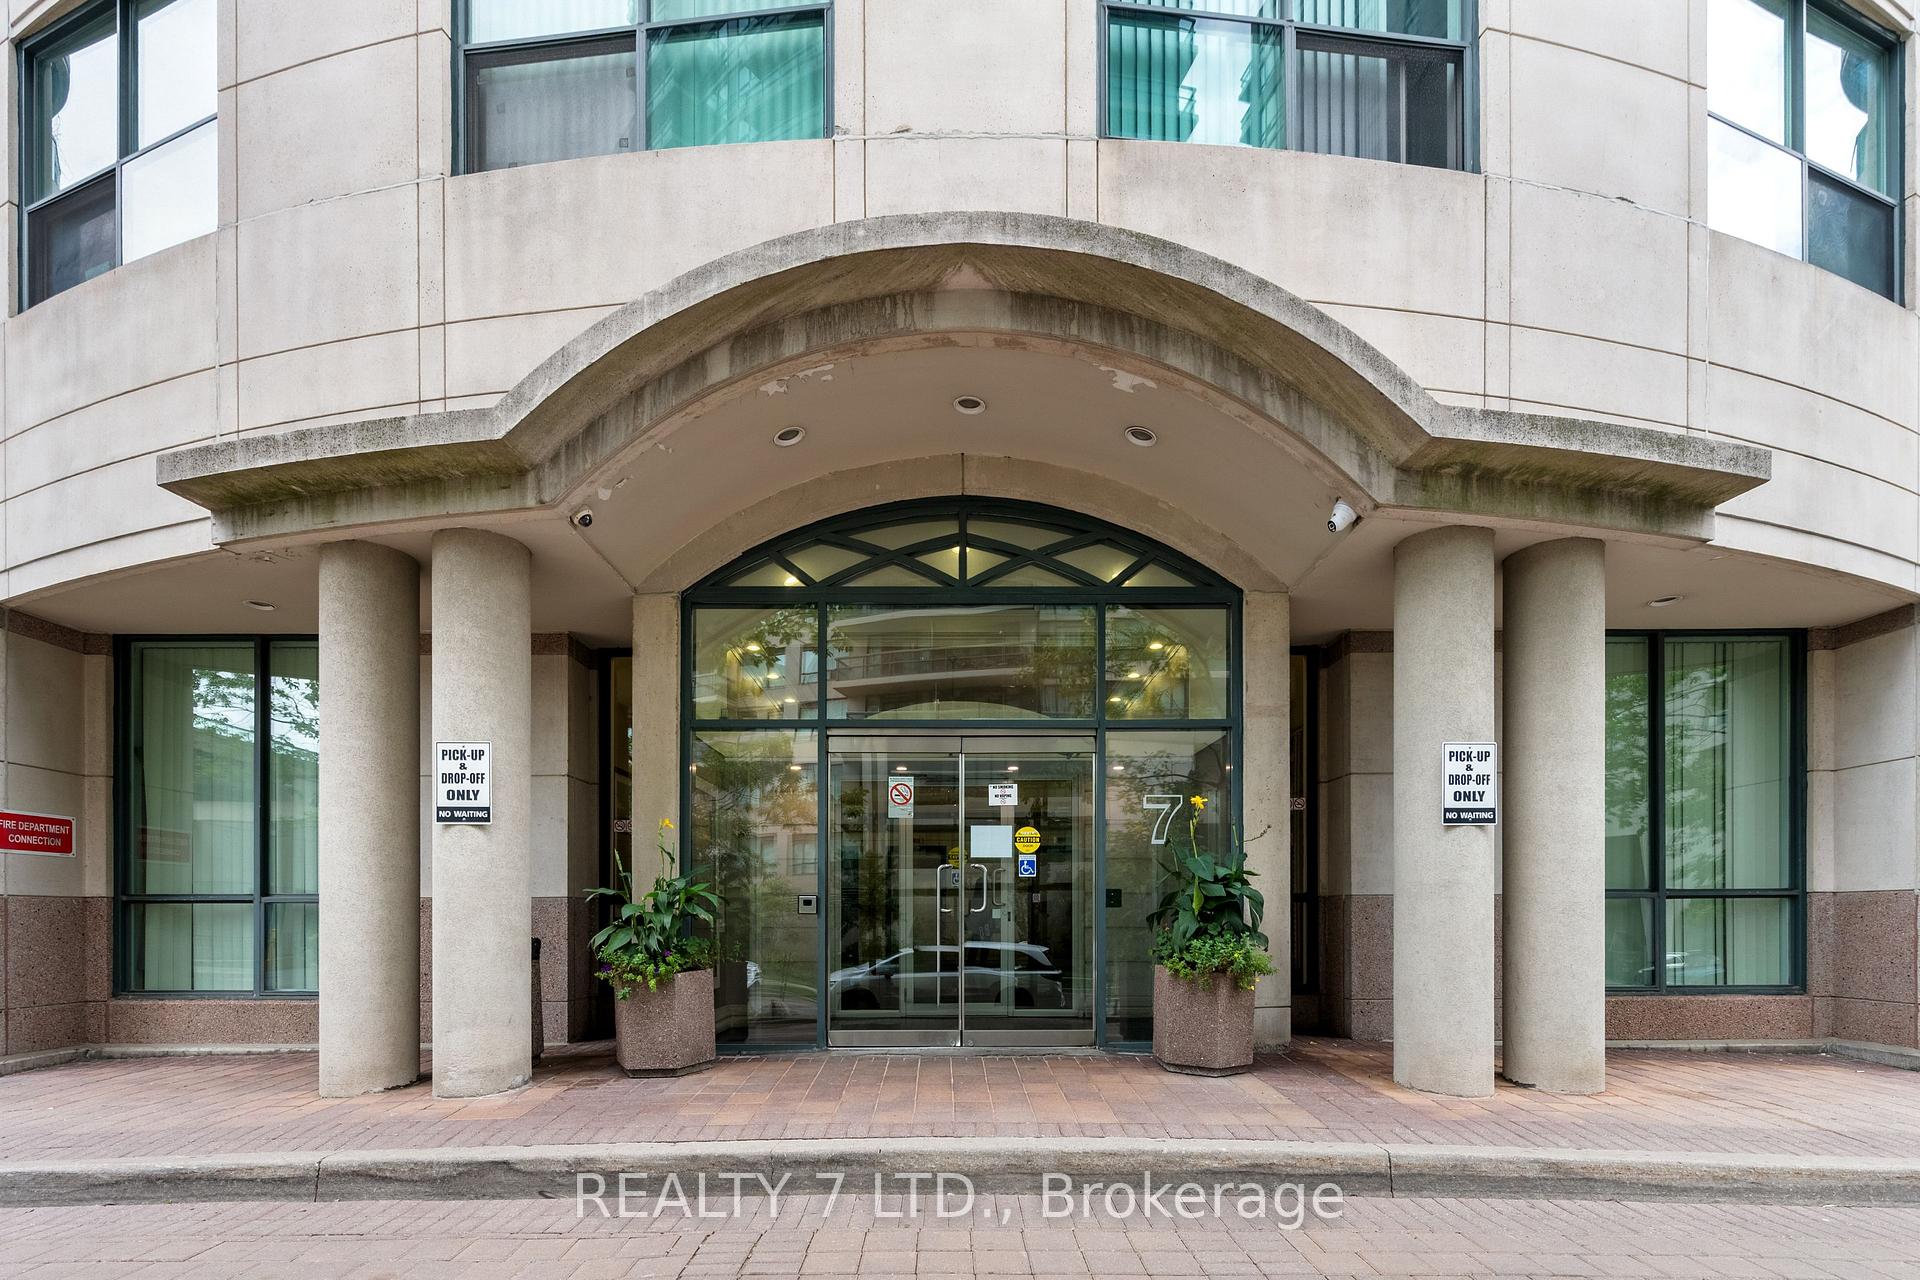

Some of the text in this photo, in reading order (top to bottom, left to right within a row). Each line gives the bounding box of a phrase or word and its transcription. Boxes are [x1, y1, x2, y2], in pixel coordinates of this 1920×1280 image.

[441, 749, 485, 761] PICK-UP
[1448, 750, 1491, 762] PICK-UP
[458, 762, 468, 771] &
[1465, 763, 1474, 772] &
[441, 772, 485, 784] DROP-OFF
[1448, 774, 1491, 786] DROP-OFF
[446, 789, 480, 801] ONLY
[1453, 790, 1486, 802] ONLY
[438, 810, 488, 818] NO WAITING
[1142, 794, 1183, 845] 7
[1445, 811, 1494, 819] NO WAITING
[18, 822, 70, 836] DEPARTMENT
[8, 833, 62, 846] CONNECTION
